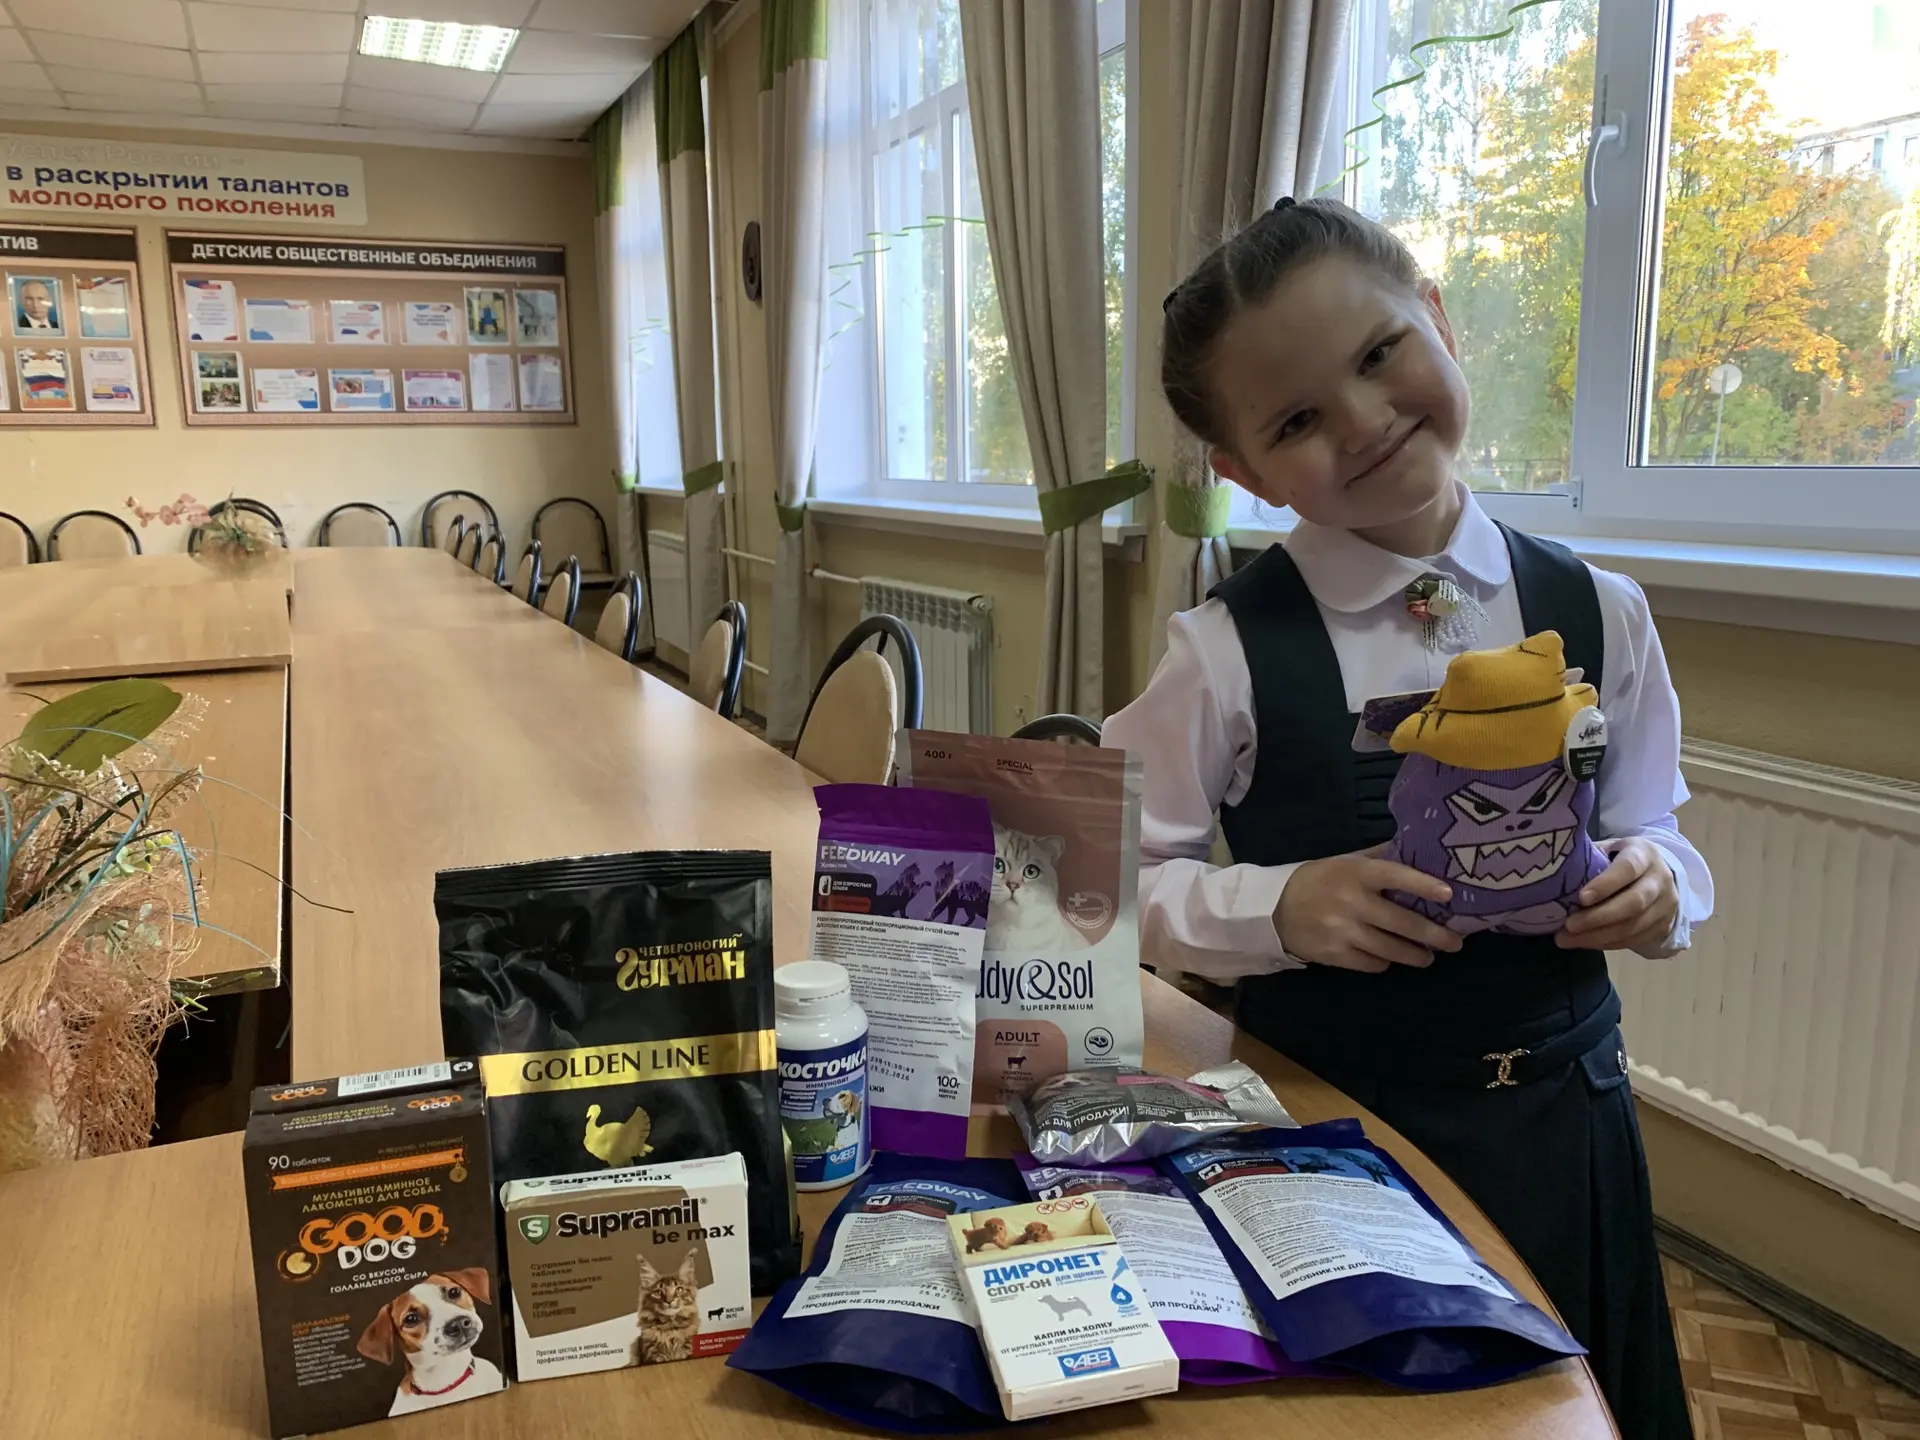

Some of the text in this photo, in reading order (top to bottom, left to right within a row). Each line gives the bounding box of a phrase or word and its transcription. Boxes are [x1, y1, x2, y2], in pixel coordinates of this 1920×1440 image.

[6, 165, 349, 198] в раскрытии талантов
[9, 189, 335, 218] молодого поколения
[0, 236, 39, 251] ТИВ
[192, 243, 537, 269] ДЕТСКИЕ ОБЩЕСТВЕННЫЕ ОБЪЕДИНЕНИЯ
[924, 749, 946, 759] 400
[996, 759, 1034, 771] SPECIAL
[820, 845, 907, 866] FEEDWAY
[638, 933, 743, 957] ЧЕТВЕРОНОГИЙ
[1020, 1003, 1094, 1012] SUPERPREMIUM
[995, 1031, 1041, 1043] ADULT
[522, 1044, 710, 1082] GOLDEN LINE
[777, 1045, 867, 1080] КОСТОЧКА
[1052, 1117, 1073, 1130] ДЛЯ
[1074, 1105, 1131, 1127] ПРОДАЖИ!
[268, 1155, 332, 1170] 90 таблеток
[549, 1168, 648, 1186] Supramil
[638, 1174, 673, 1182] max
[302, 1184, 442, 1214] ЛАКОМСТВО ДЛЯ СОБАК
[312, 1176, 431, 1203] МУЛЬТИВИТАМИННОЕ
[876, 1182, 989, 1202] FEEDWAY
[556, 1197, 700, 1239] Supramil
[299, 1203, 446, 1255] GOOD
[652, 1224, 735, 1246] be max
[337, 1236, 417, 1270] DOG
[352, 1266, 406, 1282] СО ВКУСОМ
[531, 1267, 573, 1277] таблетки
[983, 1251, 1102, 1288] ДИРОНЕТ
[1286, 1267, 1333, 1287] ПРОБНИК
[1348, 1260, 1369, 1271] ДЛЯ
[330, 1270, 428, 1294] ГОЛЛАНДСКОГО СЫРА
[987, 1277, 1052, 1298] СПОТ-ОН
[802, 1299, 850, 1310] ПРОБНИК
[887, 1299, 940, 1311] ПРОДАЖИ
[1115, 1291, 1126, 1301] 4
[1168, 1301, 1220, 1313] ПРОДАЖИ
[1034, 1321, 1113, 1341] КАПЛИ НА ХОЛКУ
[1011, 1341, 1048, 1354] КРУГЛЫХ
[1054, 1332, 1100, 1345] ЛЕНТОЧНЫХ
